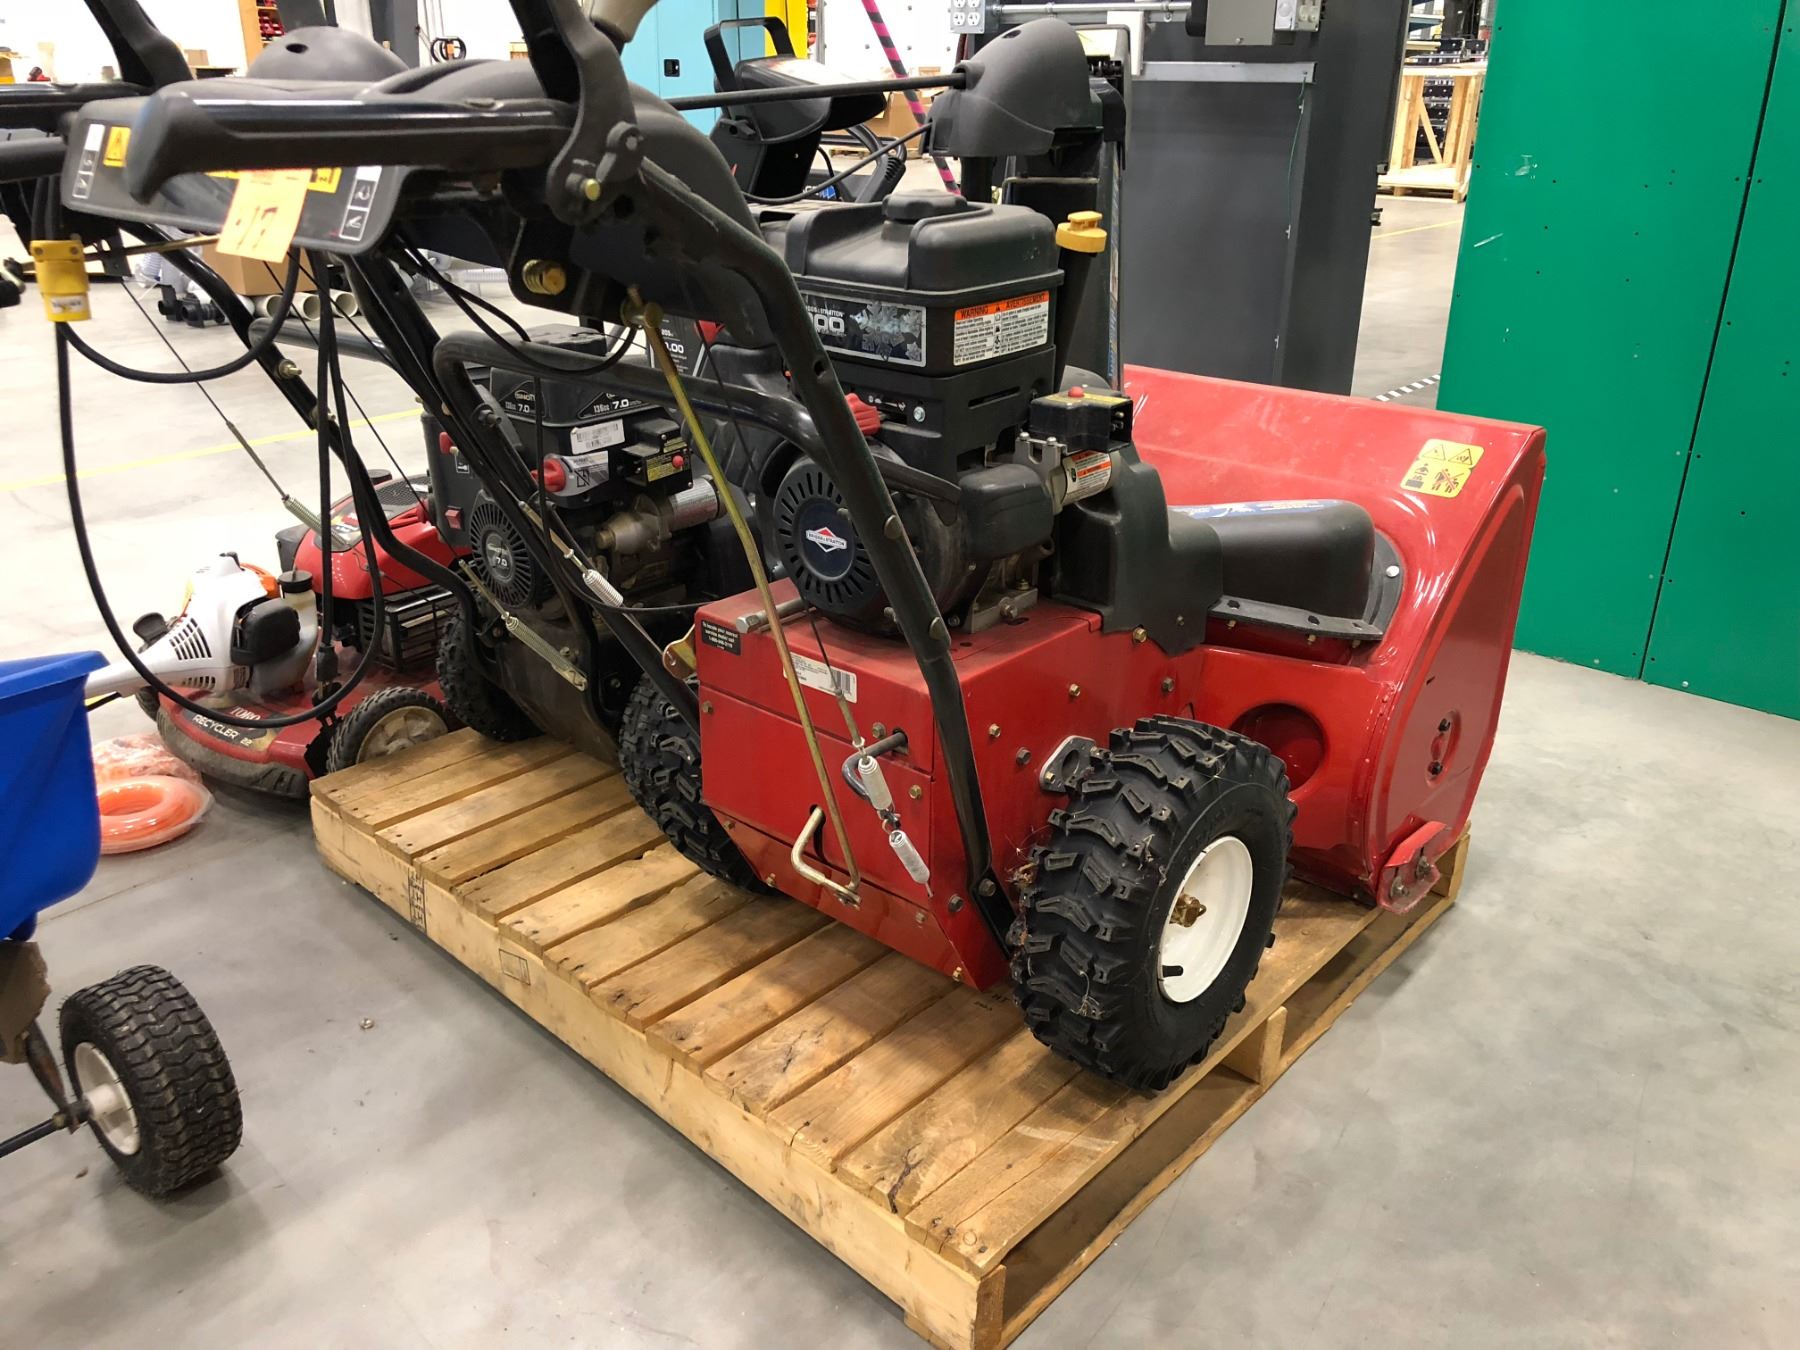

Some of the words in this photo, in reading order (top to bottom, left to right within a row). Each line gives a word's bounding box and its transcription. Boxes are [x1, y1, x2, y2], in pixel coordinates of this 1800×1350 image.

[961, 304, 989, 319] WARNING
[518, 403, 530, 413] 7.0
[612, 398, 629, 410] 7.0
[231, 706, 261, 720] TORO
[192, 714, 240, 740] RECYCLER
[240, 737, 253, 747] 22
